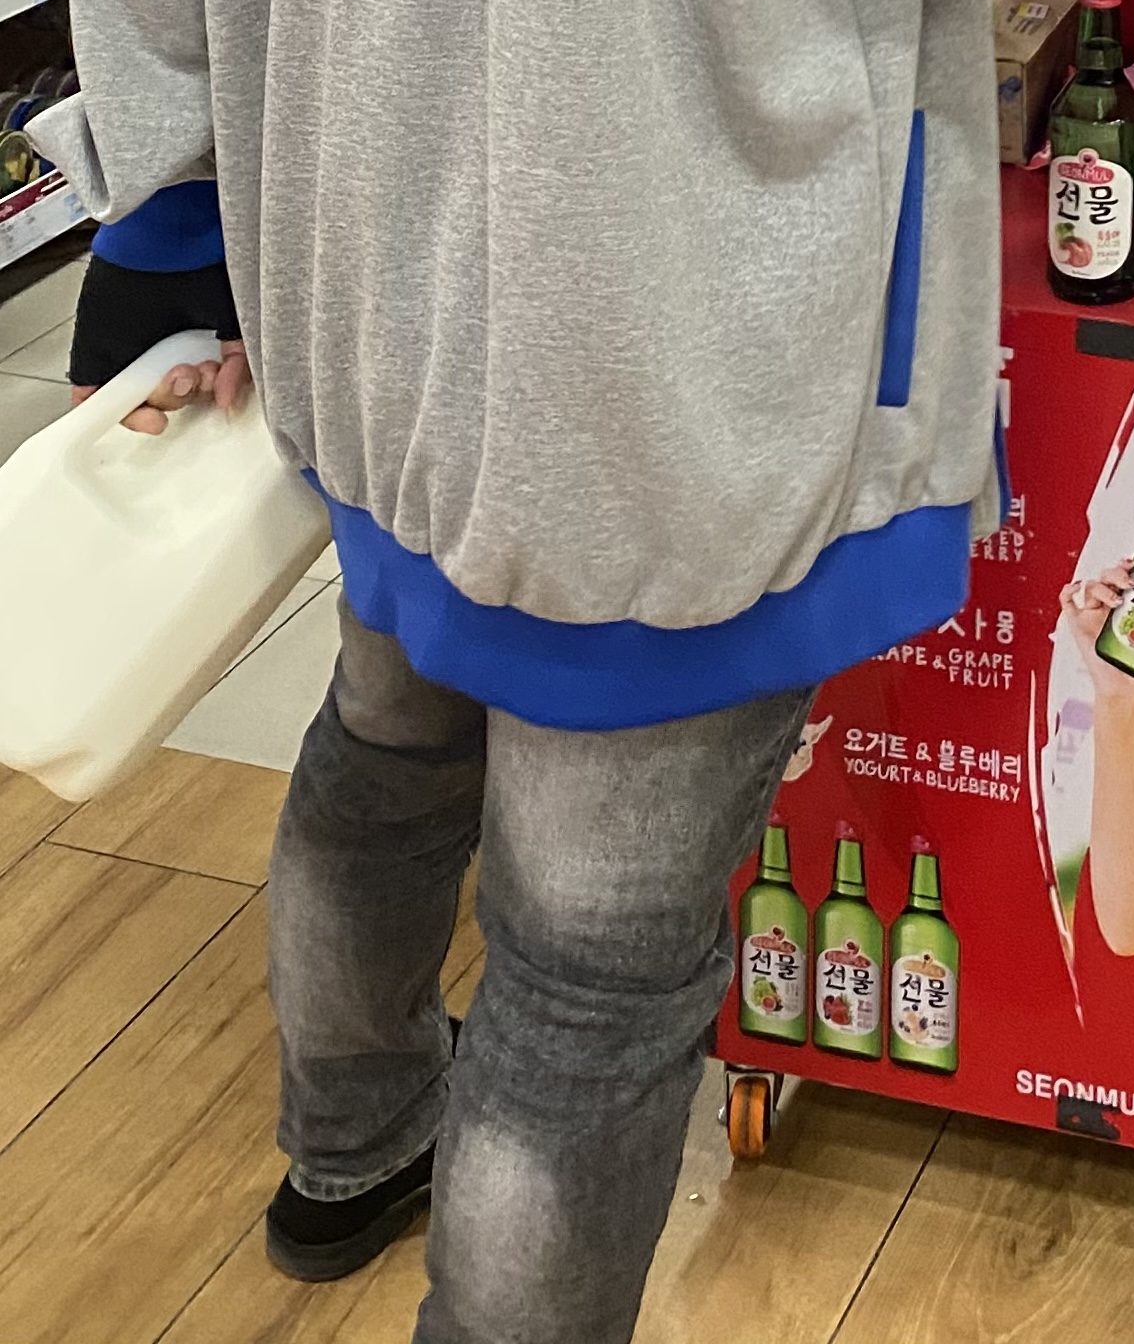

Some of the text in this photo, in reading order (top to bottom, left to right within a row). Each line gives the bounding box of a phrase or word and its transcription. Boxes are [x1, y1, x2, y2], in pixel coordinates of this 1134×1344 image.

[932, 655, 947, 670] &
[948, 648, 1014, 671] GRAPE
[949, 665, 1014, 691] FRUIT
[843, 728, 1022, 784] 요거트 & 블루베리
[925, 770, 1021, 803] BLUEBERRY
